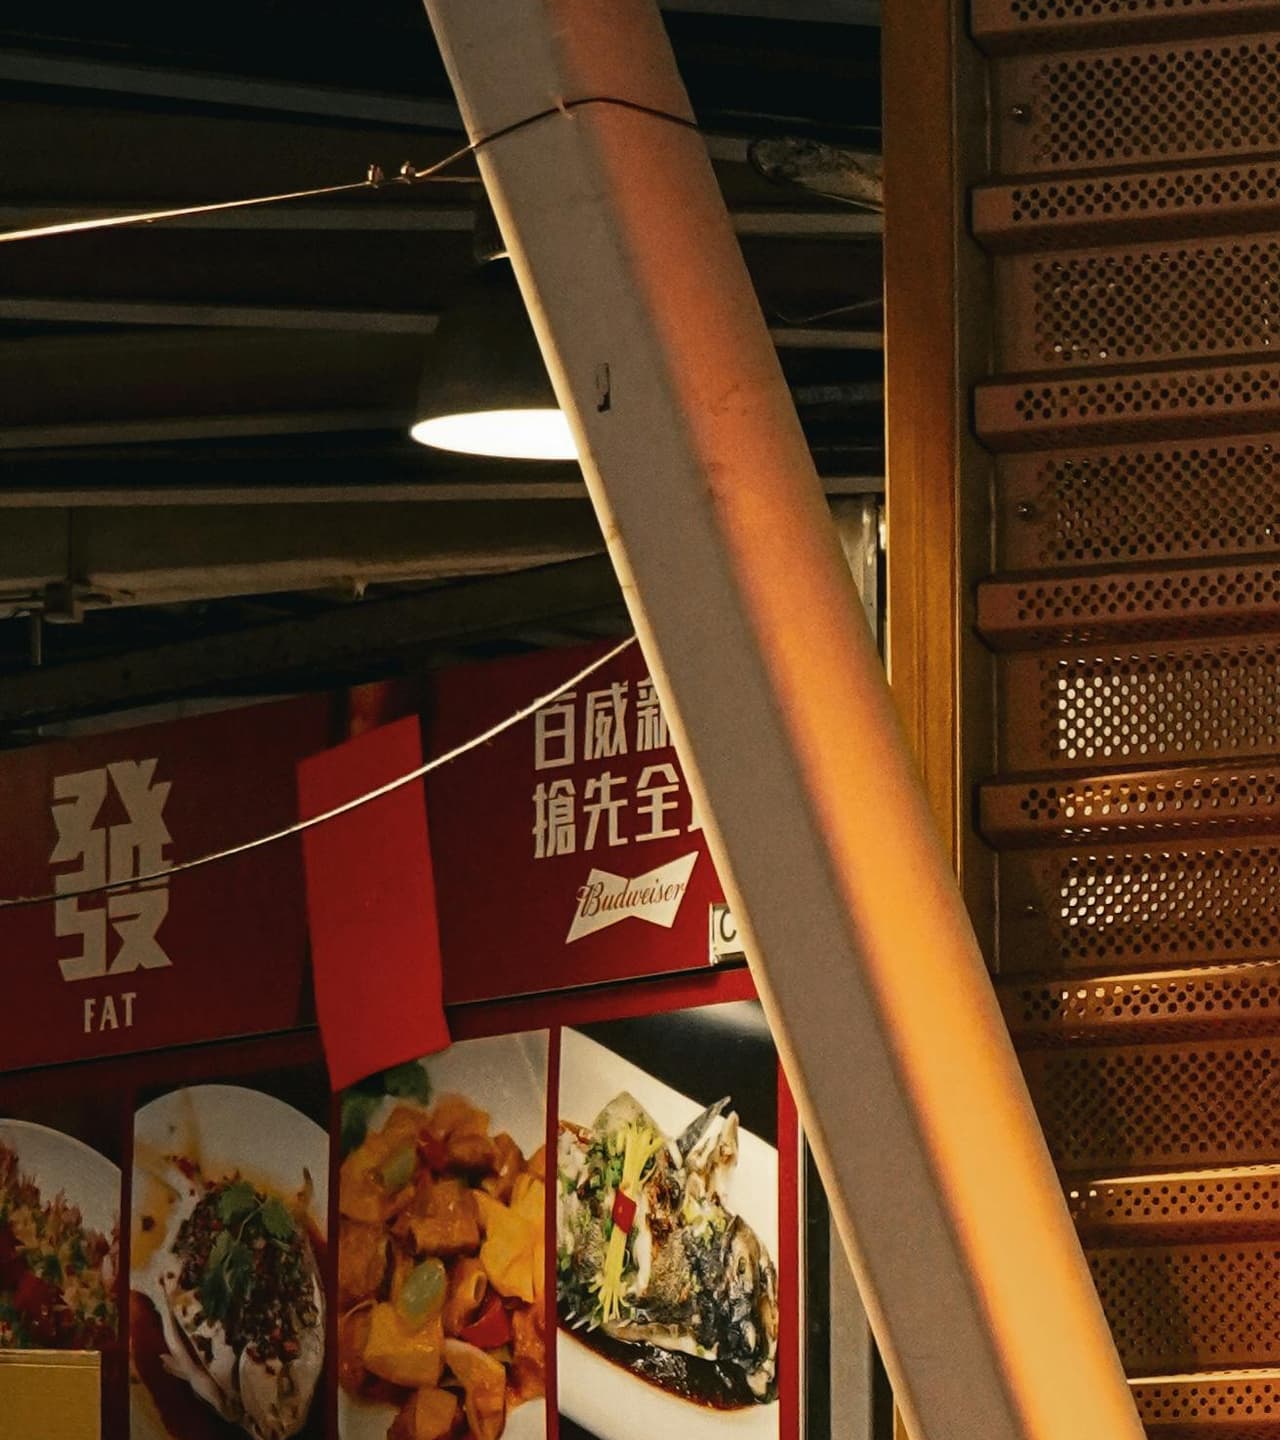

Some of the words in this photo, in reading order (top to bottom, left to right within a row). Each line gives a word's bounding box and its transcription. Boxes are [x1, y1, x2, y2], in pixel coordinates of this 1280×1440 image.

[532, 762, 702, 859] 搶先全
[49, 758, 173, 981] 發
[576, 878, 687, 918] Budweiser
[84, 992, 137, 1032] FAT
